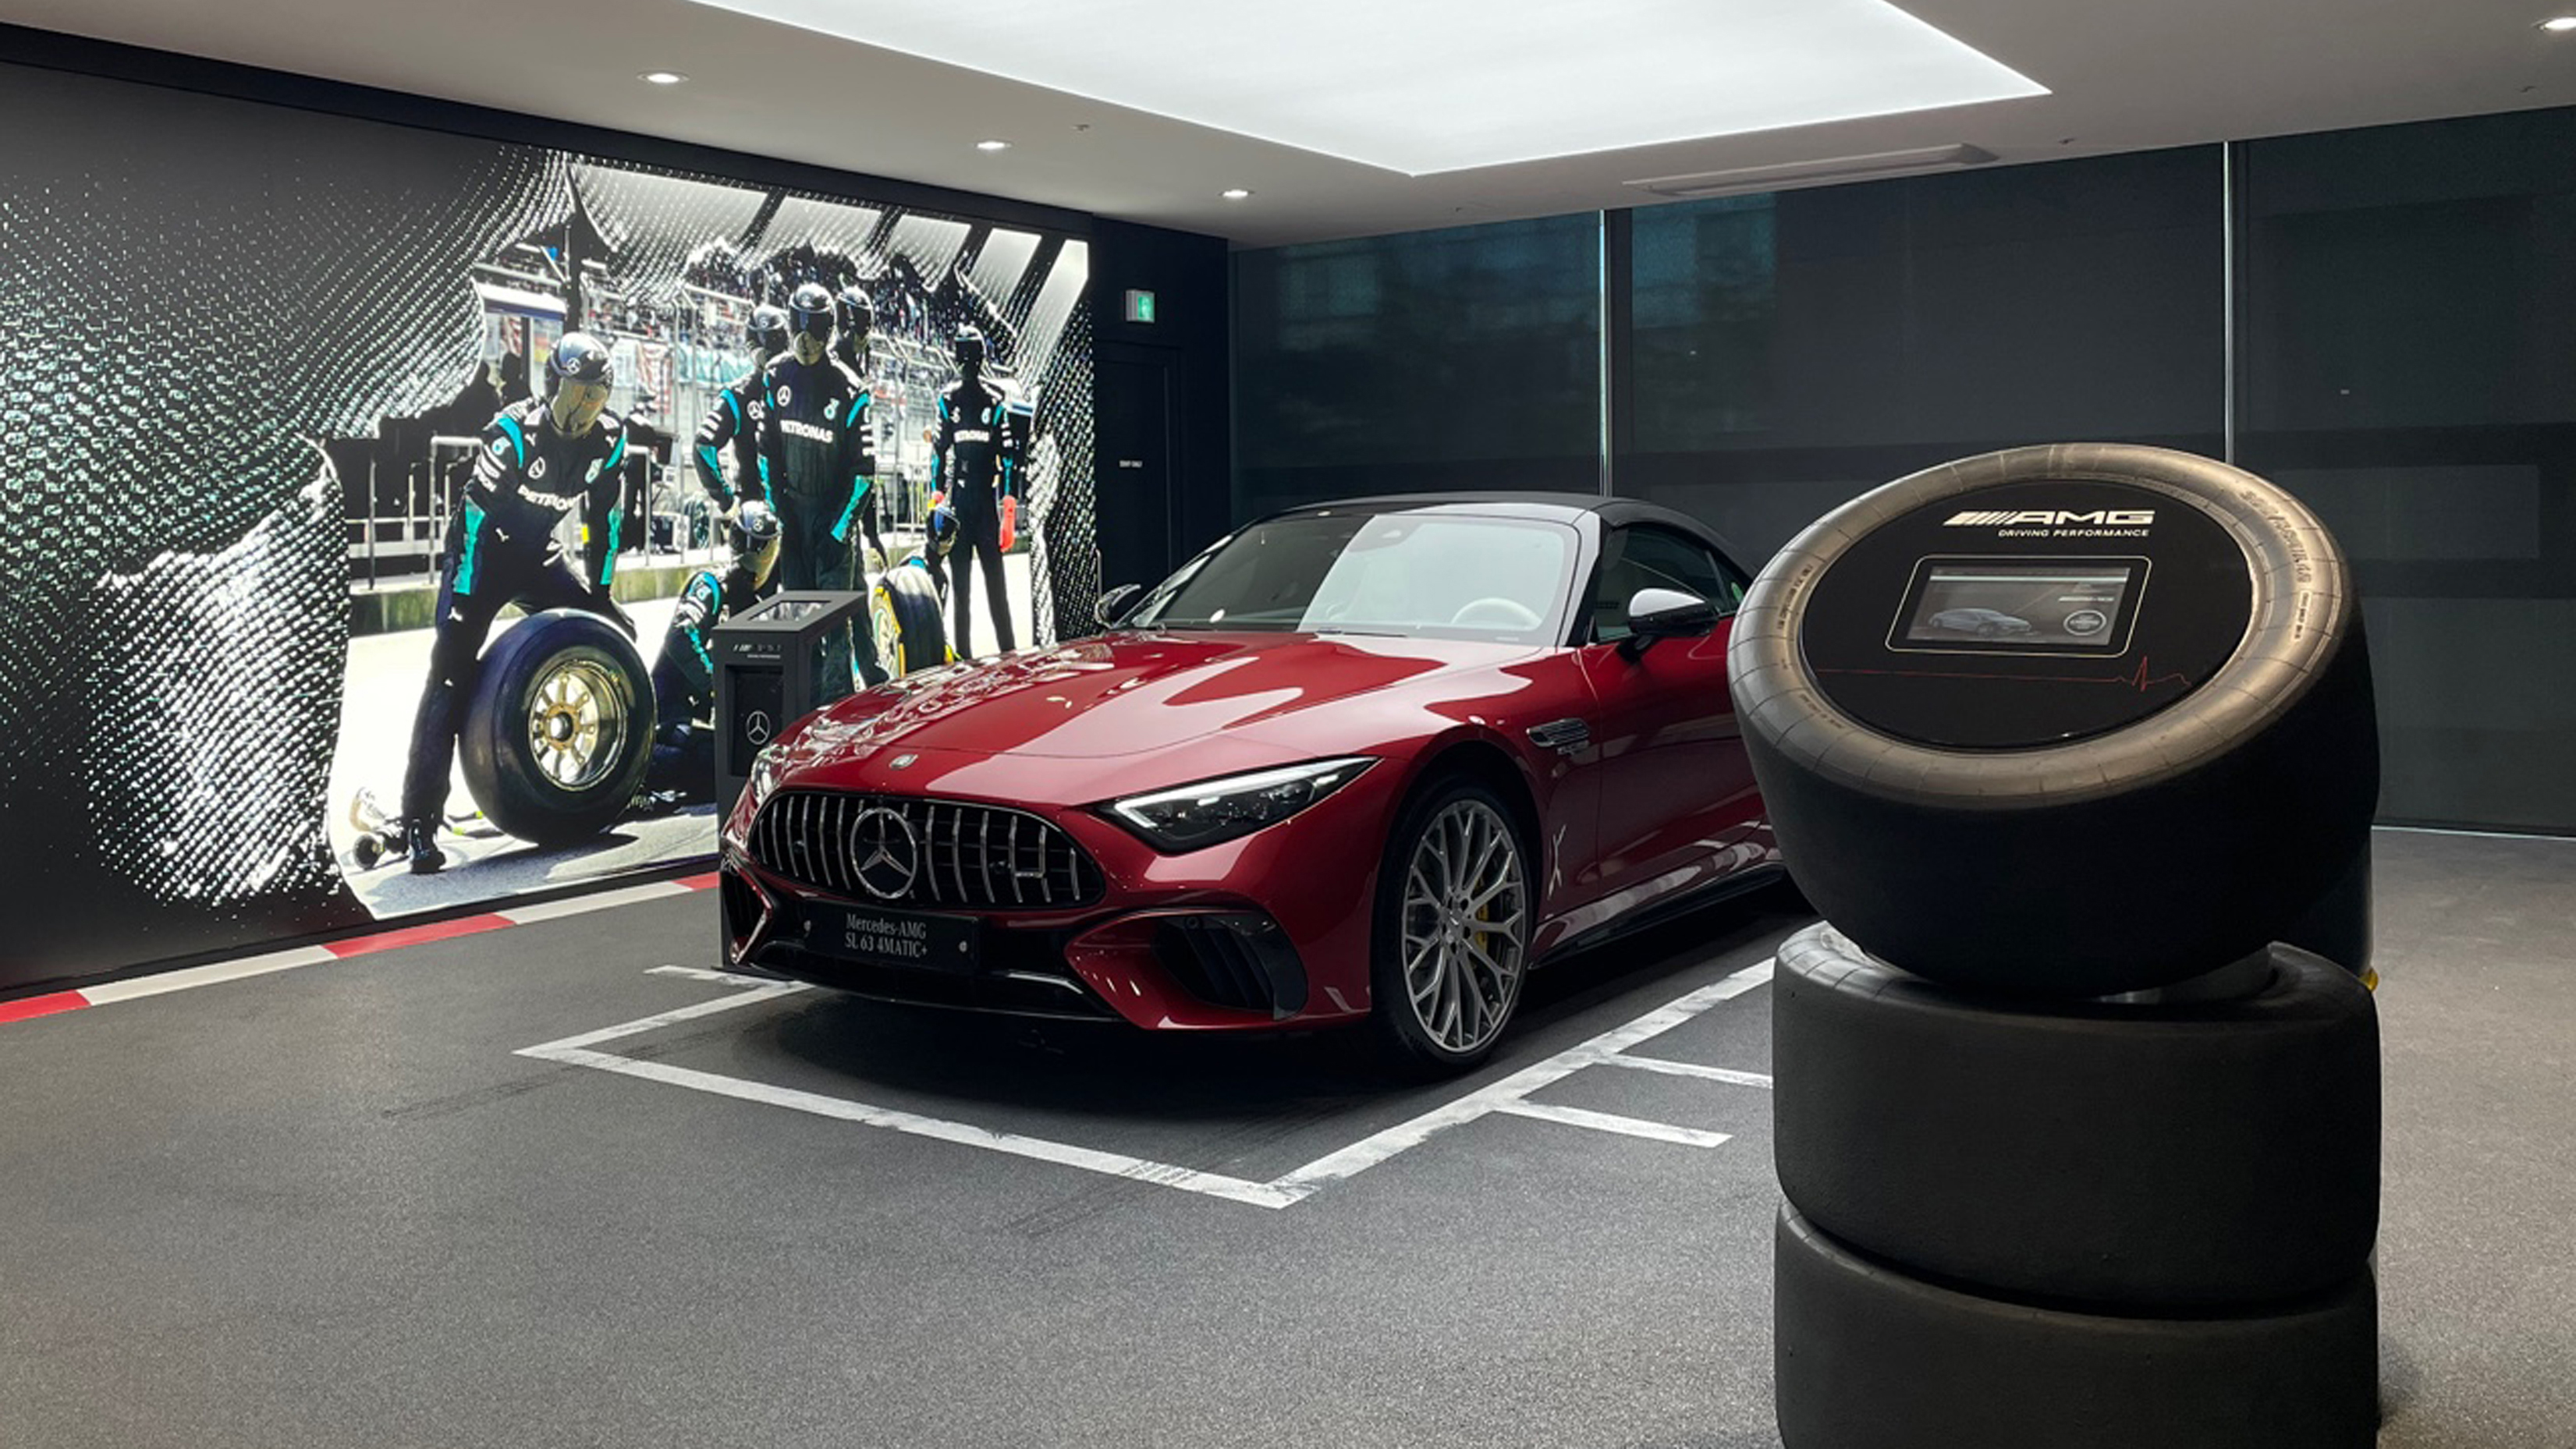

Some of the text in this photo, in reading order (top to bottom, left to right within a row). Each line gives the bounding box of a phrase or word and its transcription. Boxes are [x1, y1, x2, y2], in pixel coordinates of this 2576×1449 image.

[2002, 511, 2156, 525] AMG
[1997, 529, 2150, 537] DRIVING PERFORMANCE
[846, 912, 927, 940] Mercedes-AMG
[844, 932, 928, 958] SL 63 4MATIC+
